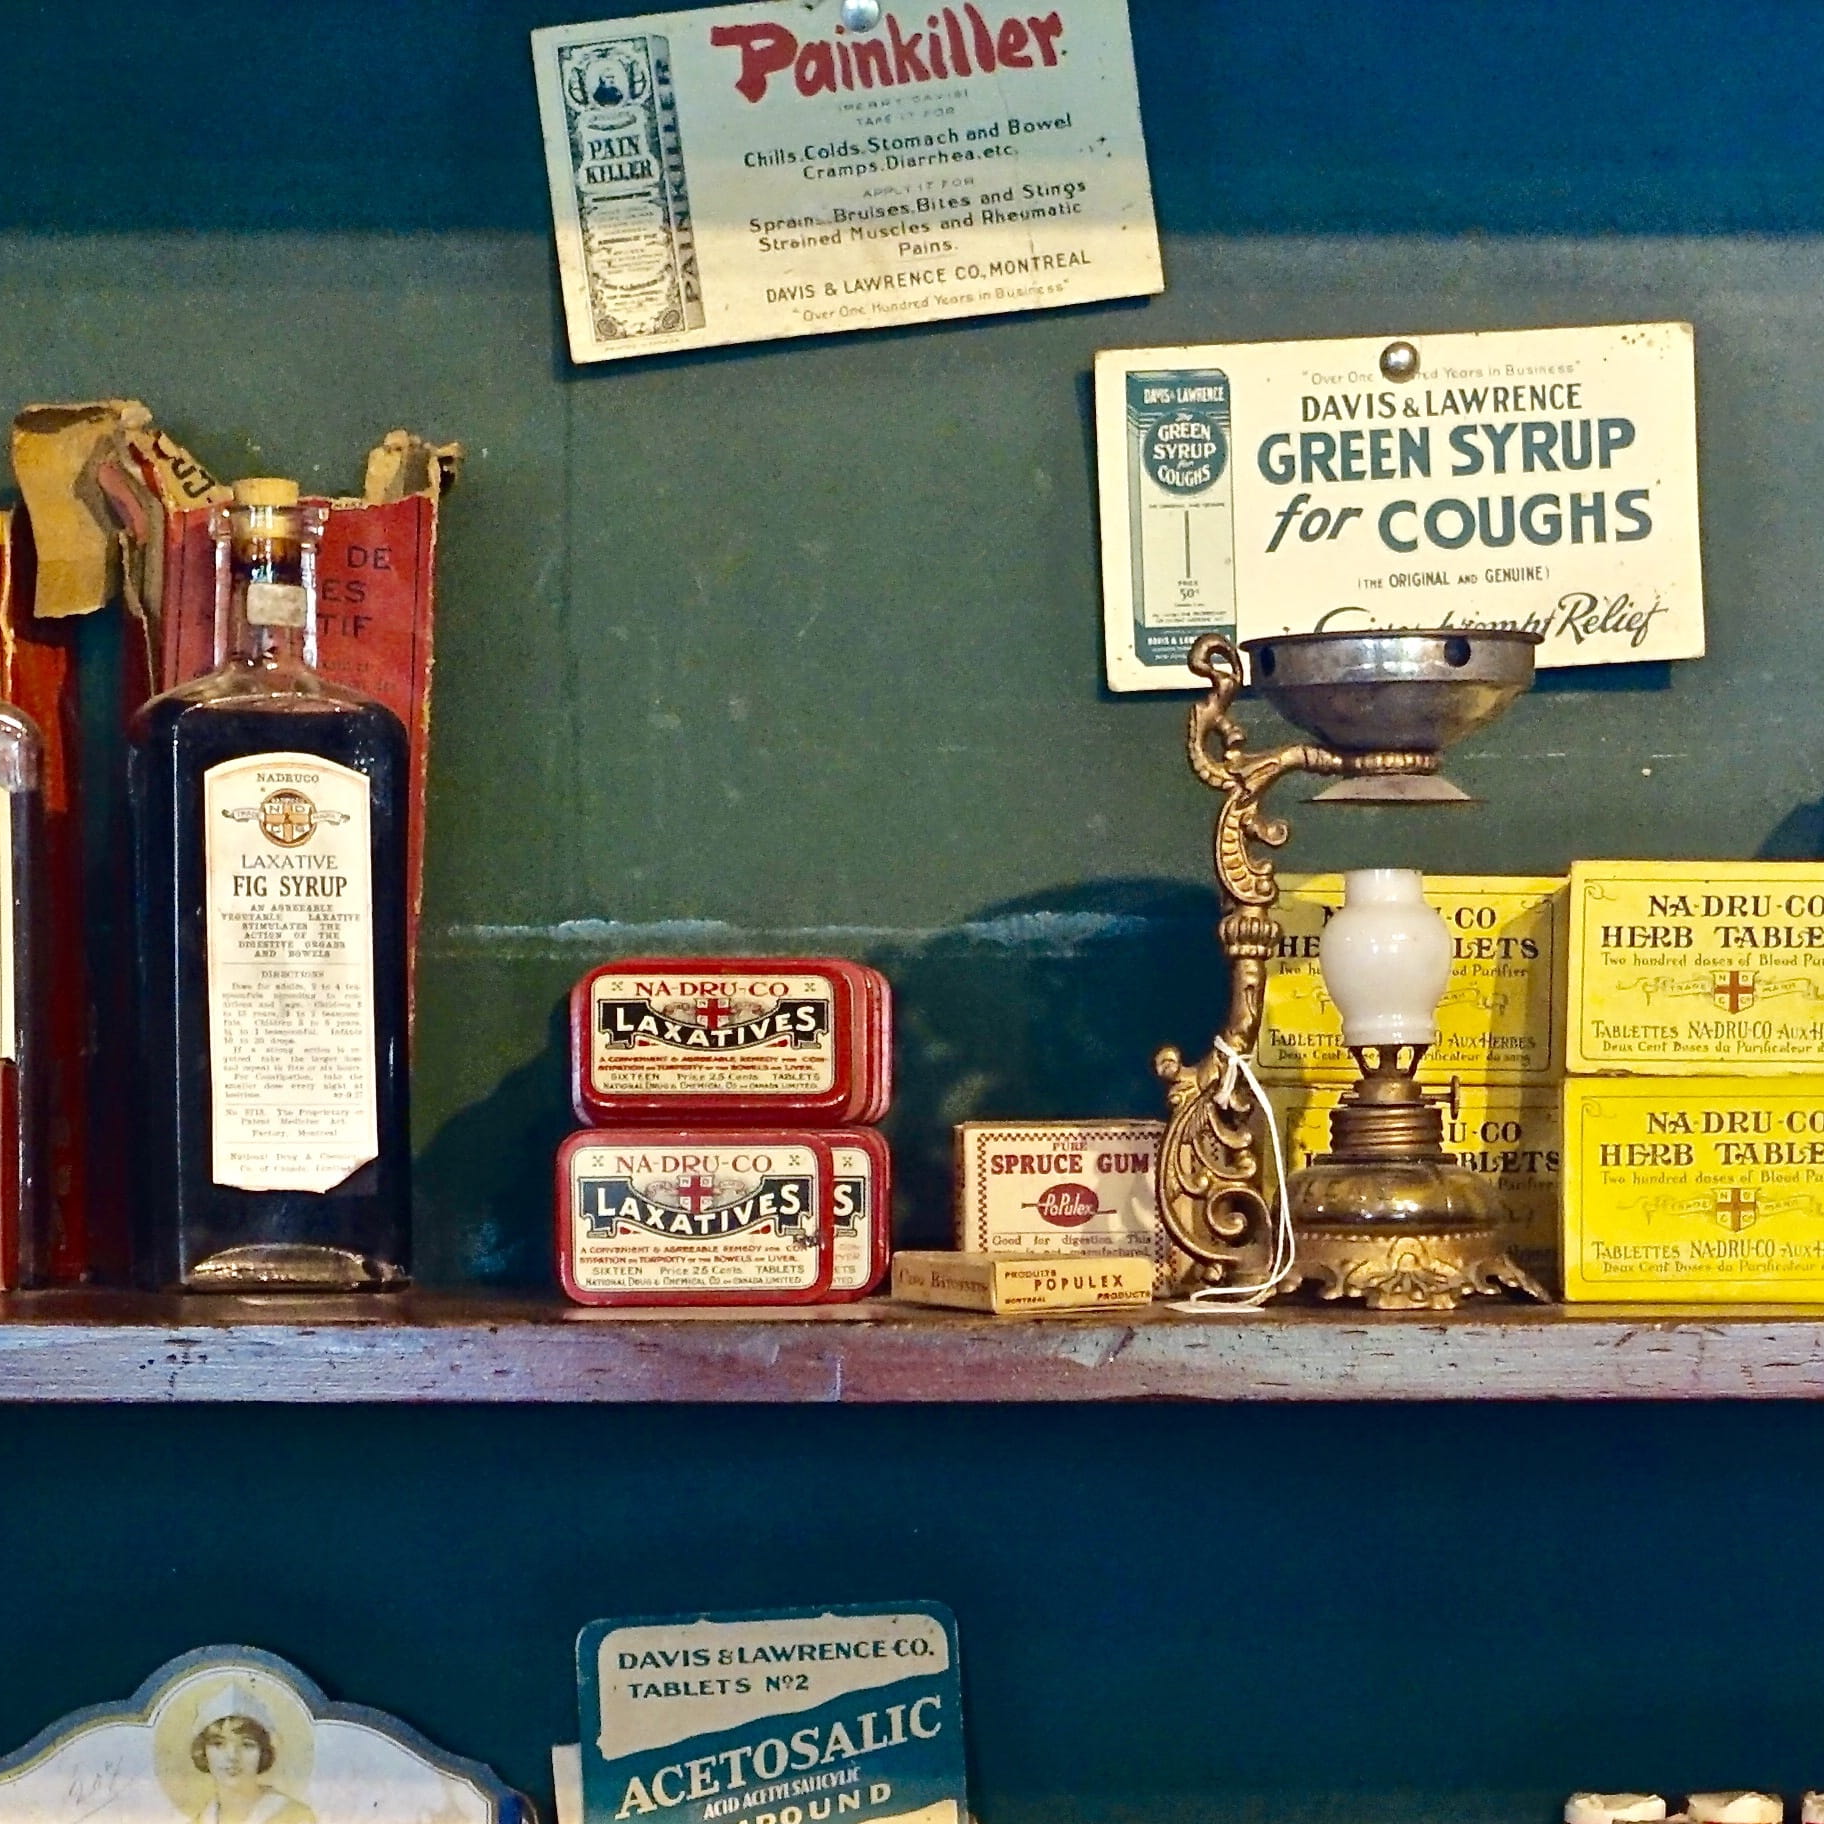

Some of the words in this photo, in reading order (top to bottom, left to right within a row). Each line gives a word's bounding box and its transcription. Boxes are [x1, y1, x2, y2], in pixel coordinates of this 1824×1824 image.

[709, 2, 1065, 104] Painkiller
[1300, 392, 1397, 423] DAVIS
[1424, 382, 1584, 417] LAWRENCE
[1156, 422, 1211, 441] GREEN
[1152, 440, 1216, 459] SYRUP
[1256, 425, 1433, 487] GREEN
[1449, 416, 1638, 477] SYRUP
[1264, 492, 1364, 555] for
[1378, 489, 1654, 554] COUGHS
[1388, 568, 1450, 587] ORIGINAL
[239, 853, 340, 871] LAXATIVE
[231, 875, 269, 899] FIG
[278, 874, 348, 899] SYRUP
[1600, 952, 1627, 968] Two
[1631, 952, 1688, 968] hundred
[1692, 954, 1732, 968] doses
[1737, 952, 1755, 968] of
[1758, 952, 1801, 968] Blood
[614, 1005, 817, 1049] LAXATIVES
[989, 1152, 1085, 1177] SPRUCE
[1096, 1151, 1151, 1175] GUM
[1598, 1140, 1696, 1168] HERB
[1032, 1276, 1125, 1290] POPULEX
[614, 1693, 944, 1823] ACETOSALIC
